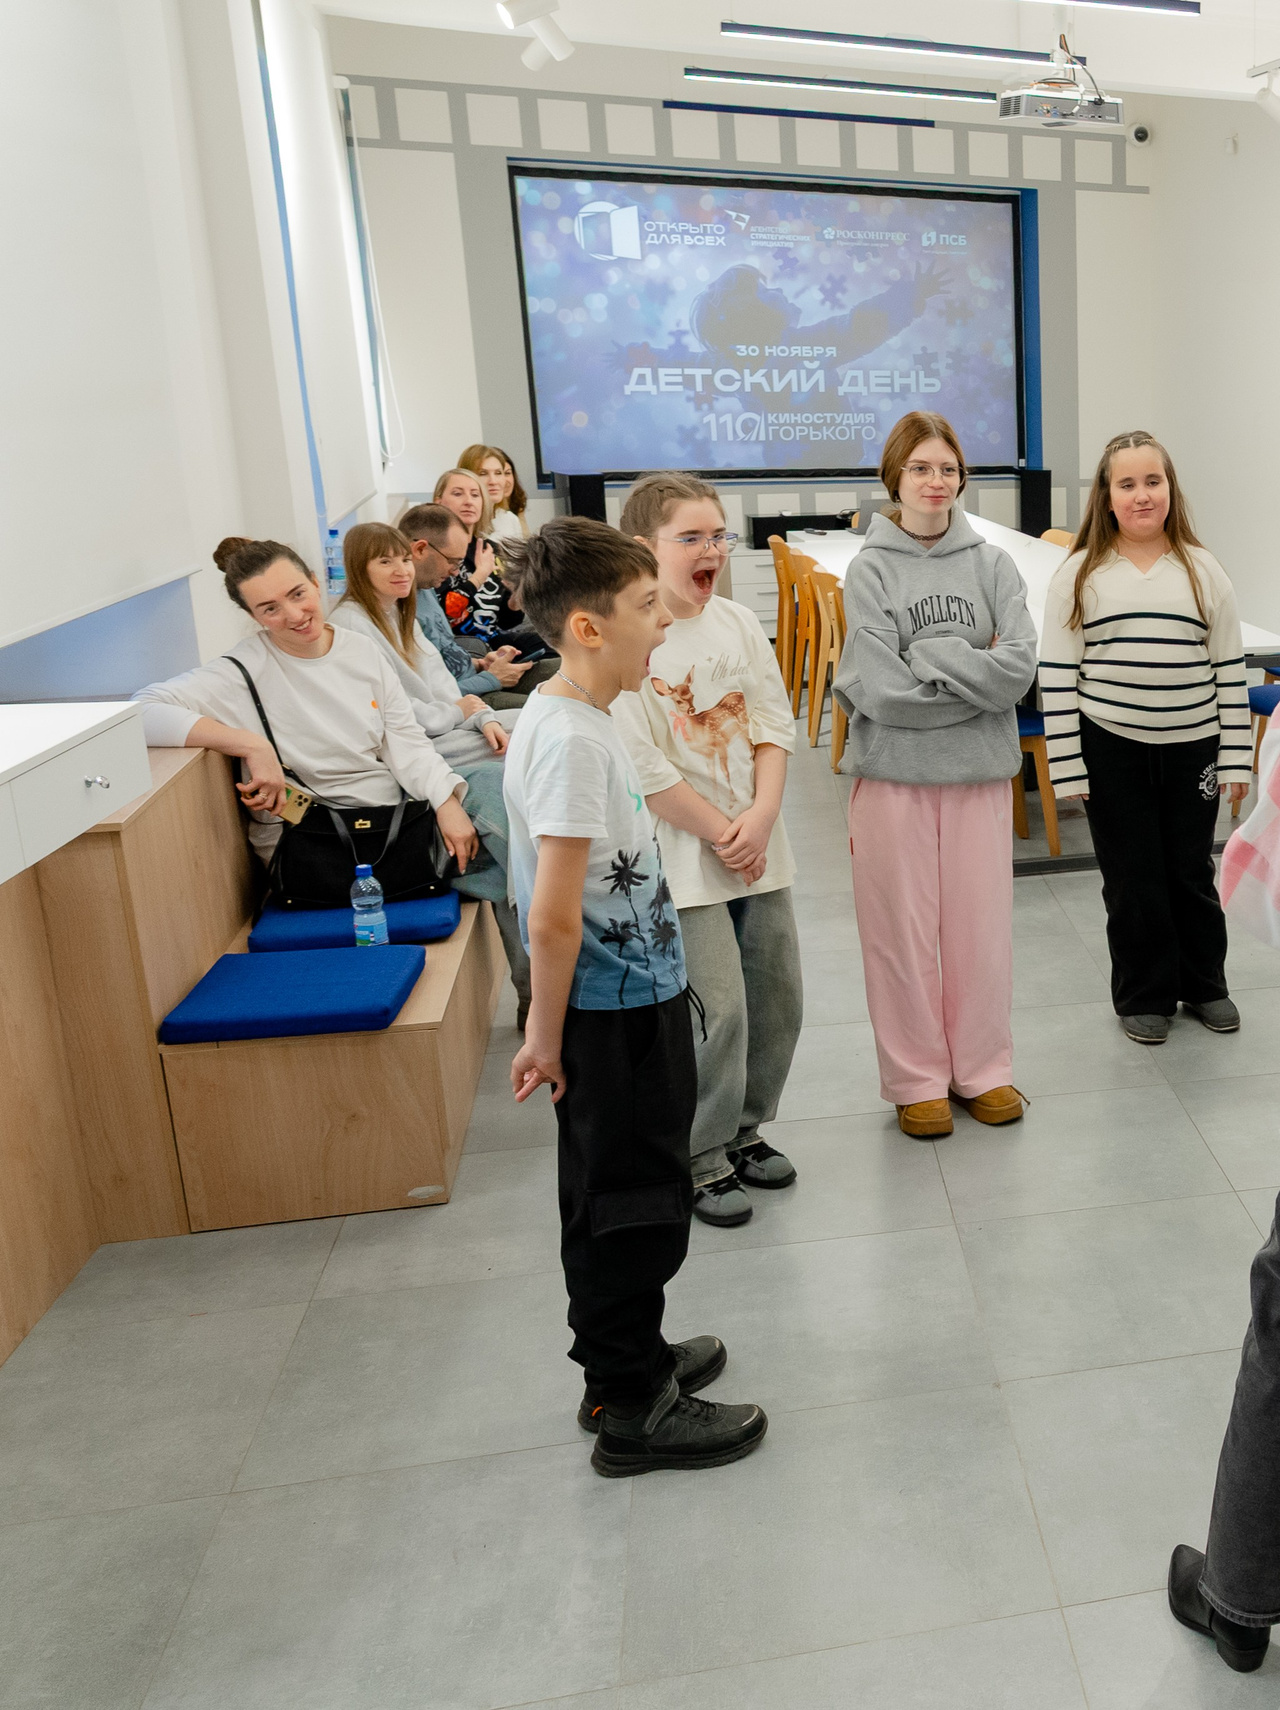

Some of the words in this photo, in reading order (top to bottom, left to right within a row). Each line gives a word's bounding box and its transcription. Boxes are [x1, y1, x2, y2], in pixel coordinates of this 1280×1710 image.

[644, 221, 726, 235] ОТКРЫТО
[750, 226, 789, 234] АГЕНТСТВО
[645, 234, 684, 246] ДЛЯ
[684, 235, 727, 247] ВСЕХ
[750, 233, 811, 242] СТРАТЕГИЧЕСКИХ
[836, 230, 910, 241] РОСКОНГРЕСС
[939, 234, 967, 246] ПСБ
[735, 345, 760, 357] 30
[765, 346, 837, 358] НОЯБРЯ
[624, 360, 826, 395] ДЕТСКИЙ
[837, 370, 942, 396] ДЕНЬ
[767, 412, 875, 426] КИНОСТУДИЯ
[768, 425, 876, 442] ГОРЬКОГО
[907, 594, 977, 636] MCLLCTN
